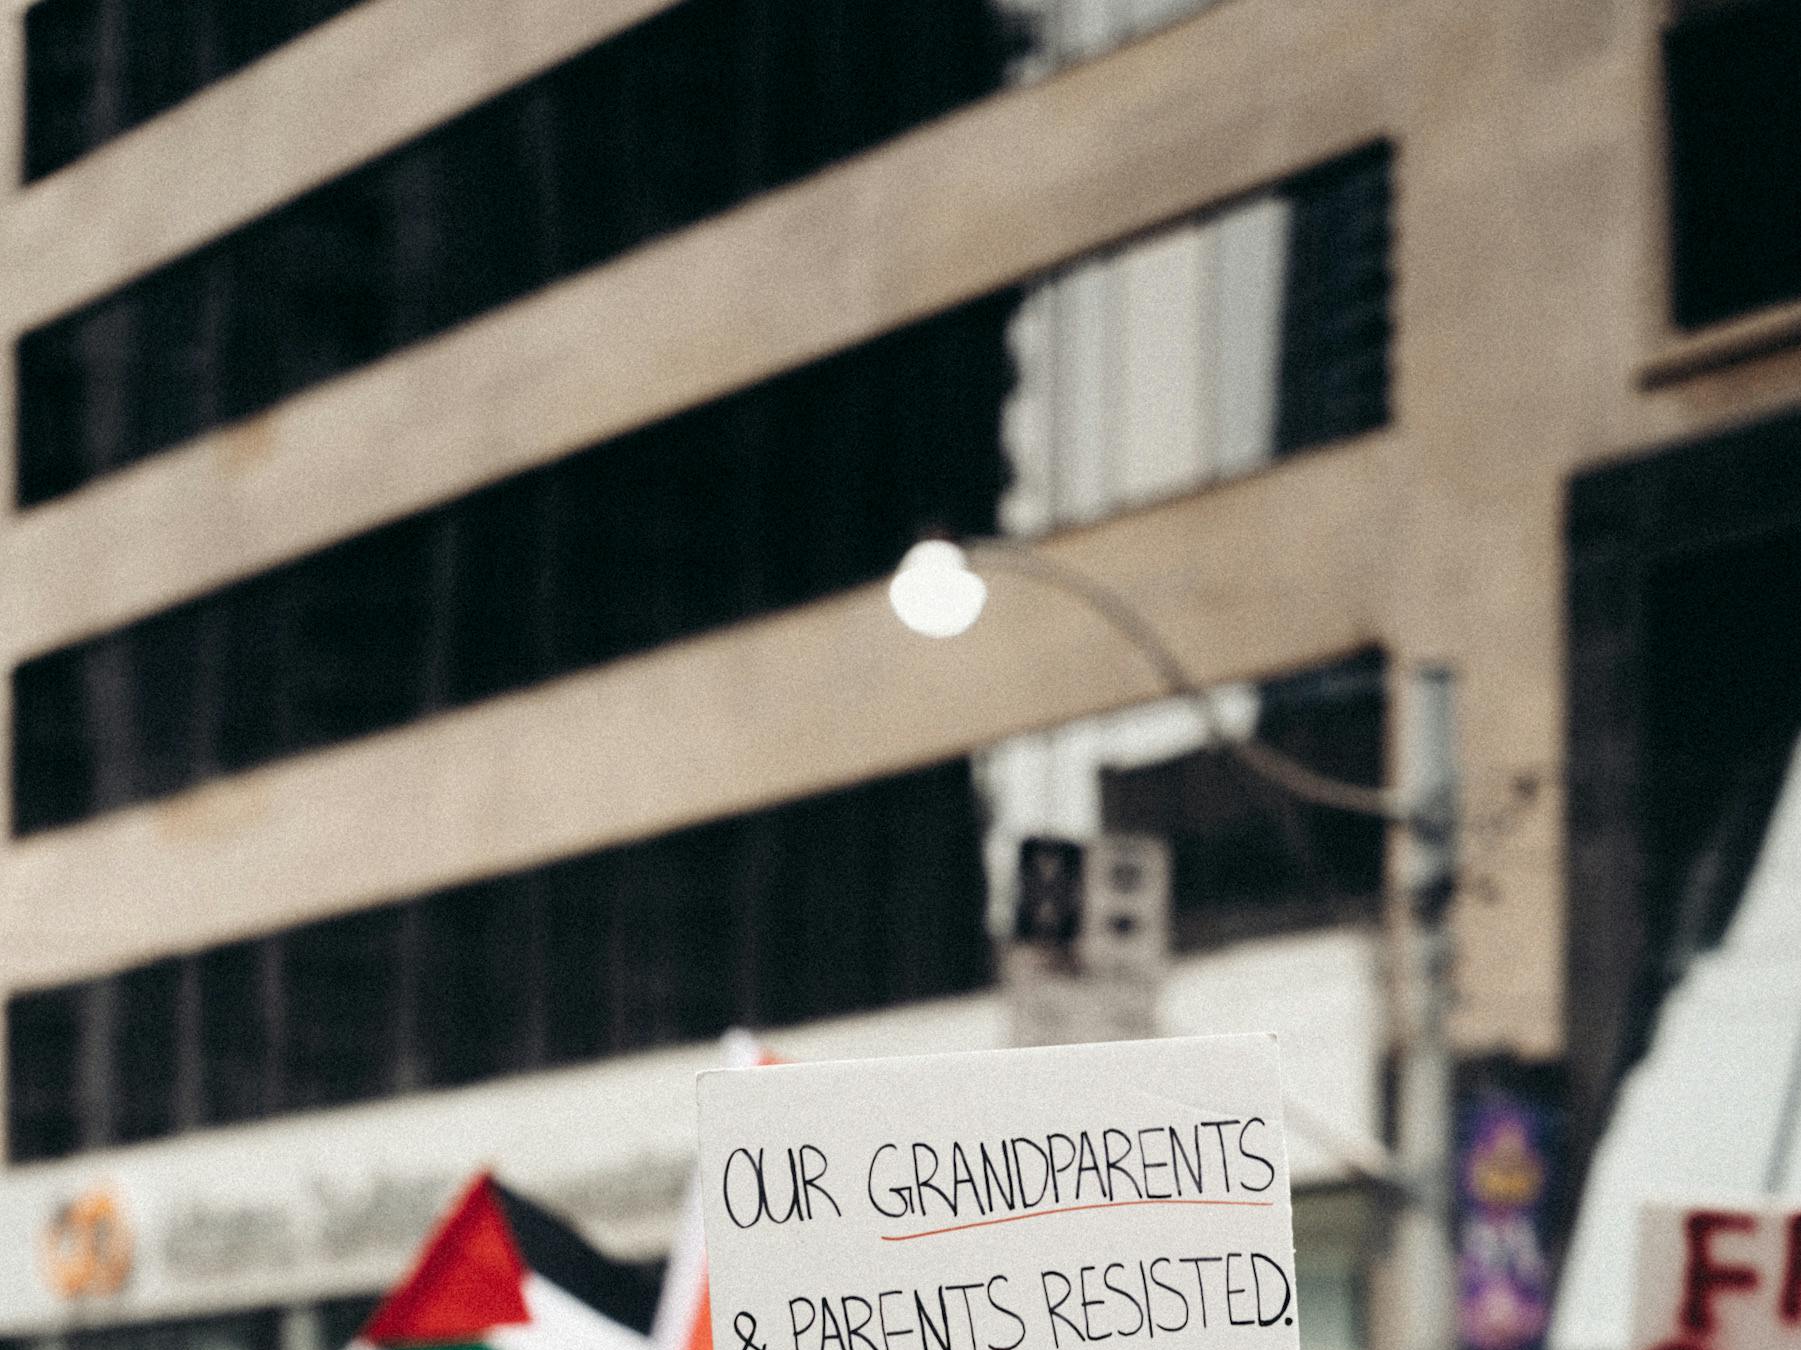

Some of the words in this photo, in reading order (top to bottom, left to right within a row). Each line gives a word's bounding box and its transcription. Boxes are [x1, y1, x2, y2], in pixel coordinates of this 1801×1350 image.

[722, 1143, 842, 1230] OUR
[867, 1116, 1276, 1219] GRANDPARENTS
[1040, 1252, 1295, 1350] RESISTED.
[1678, 1207, 1801, 1336] F
